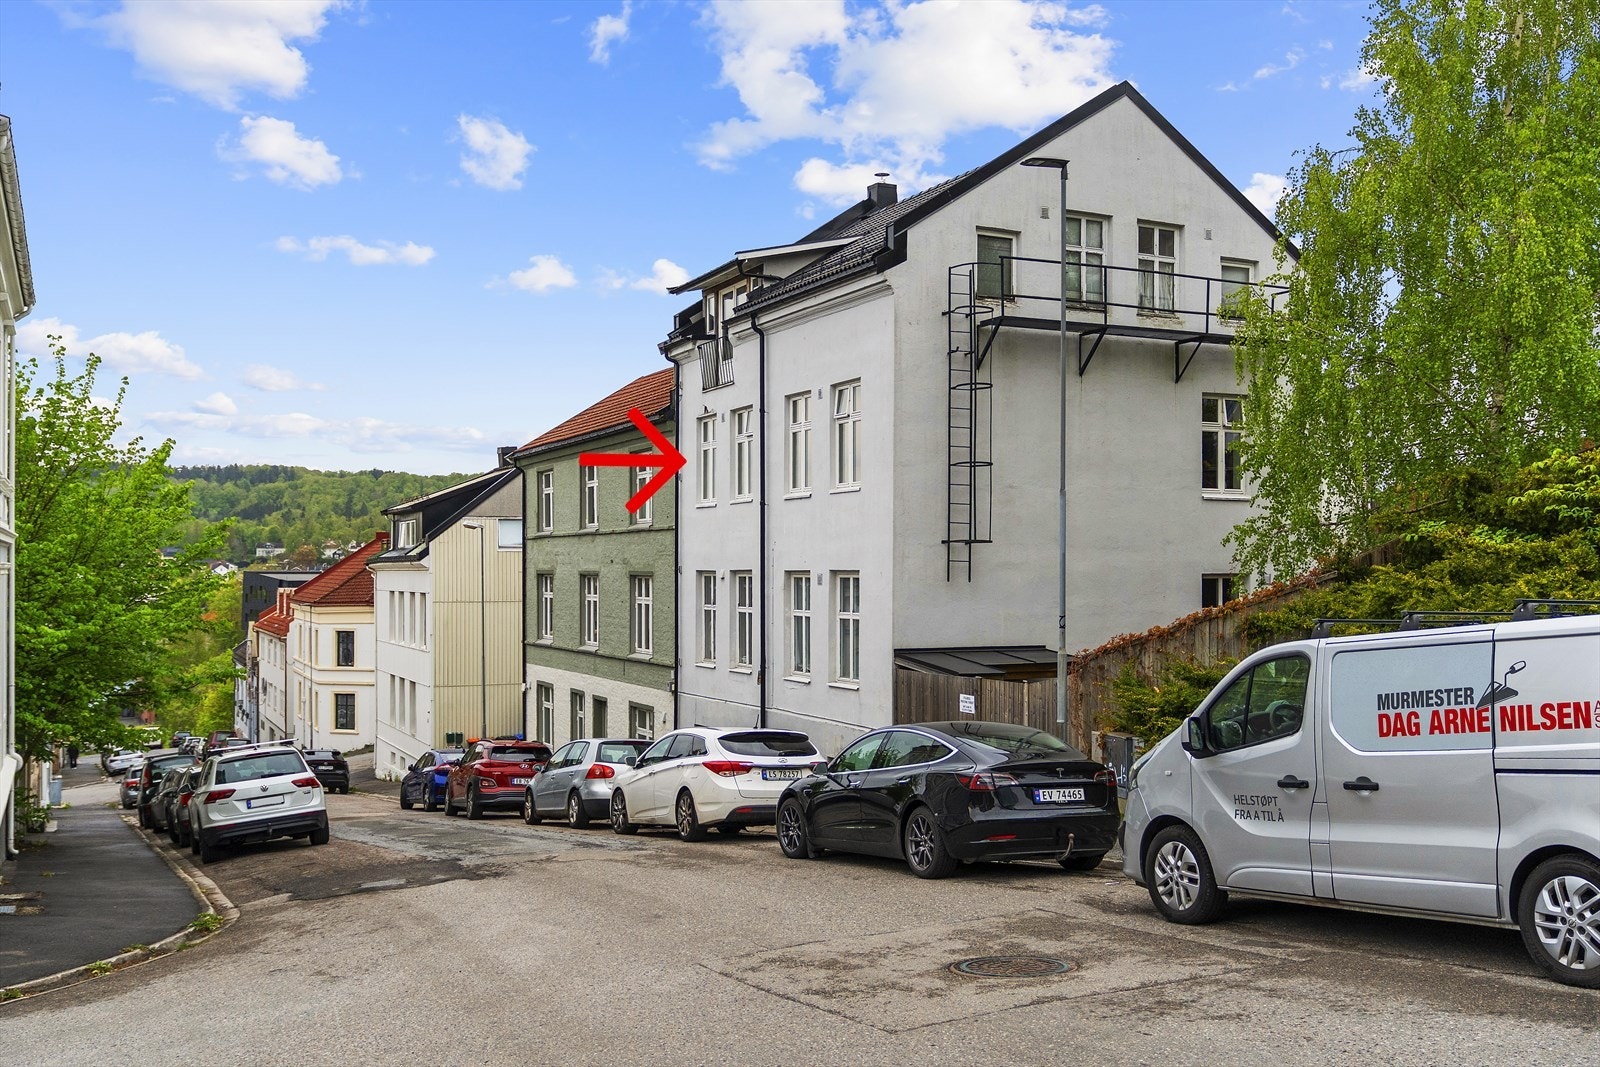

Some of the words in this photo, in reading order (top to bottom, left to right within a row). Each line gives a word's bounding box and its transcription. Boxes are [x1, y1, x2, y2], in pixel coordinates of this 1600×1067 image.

[1377, 687, 1475, 711] MURMESTER
[1378, 711, 1421, 738] DAG
[1429, 708, 1491, 735] ARNE
[1500, 701, 1592, 732] NILSEN
[769, 770, 777, 778] LS
[1042, 790, 1053, 800] EV
[1056, 789, 1082, 800] 74465
[1233, 794, 1278, 807] HELSTØPT
[1234, 809, 1252, 820] FRA
[1253, 810, 1260, 821] A
[1261, 810, 1276, 822] TIL
[1277, 808, 1284, 822] Å
